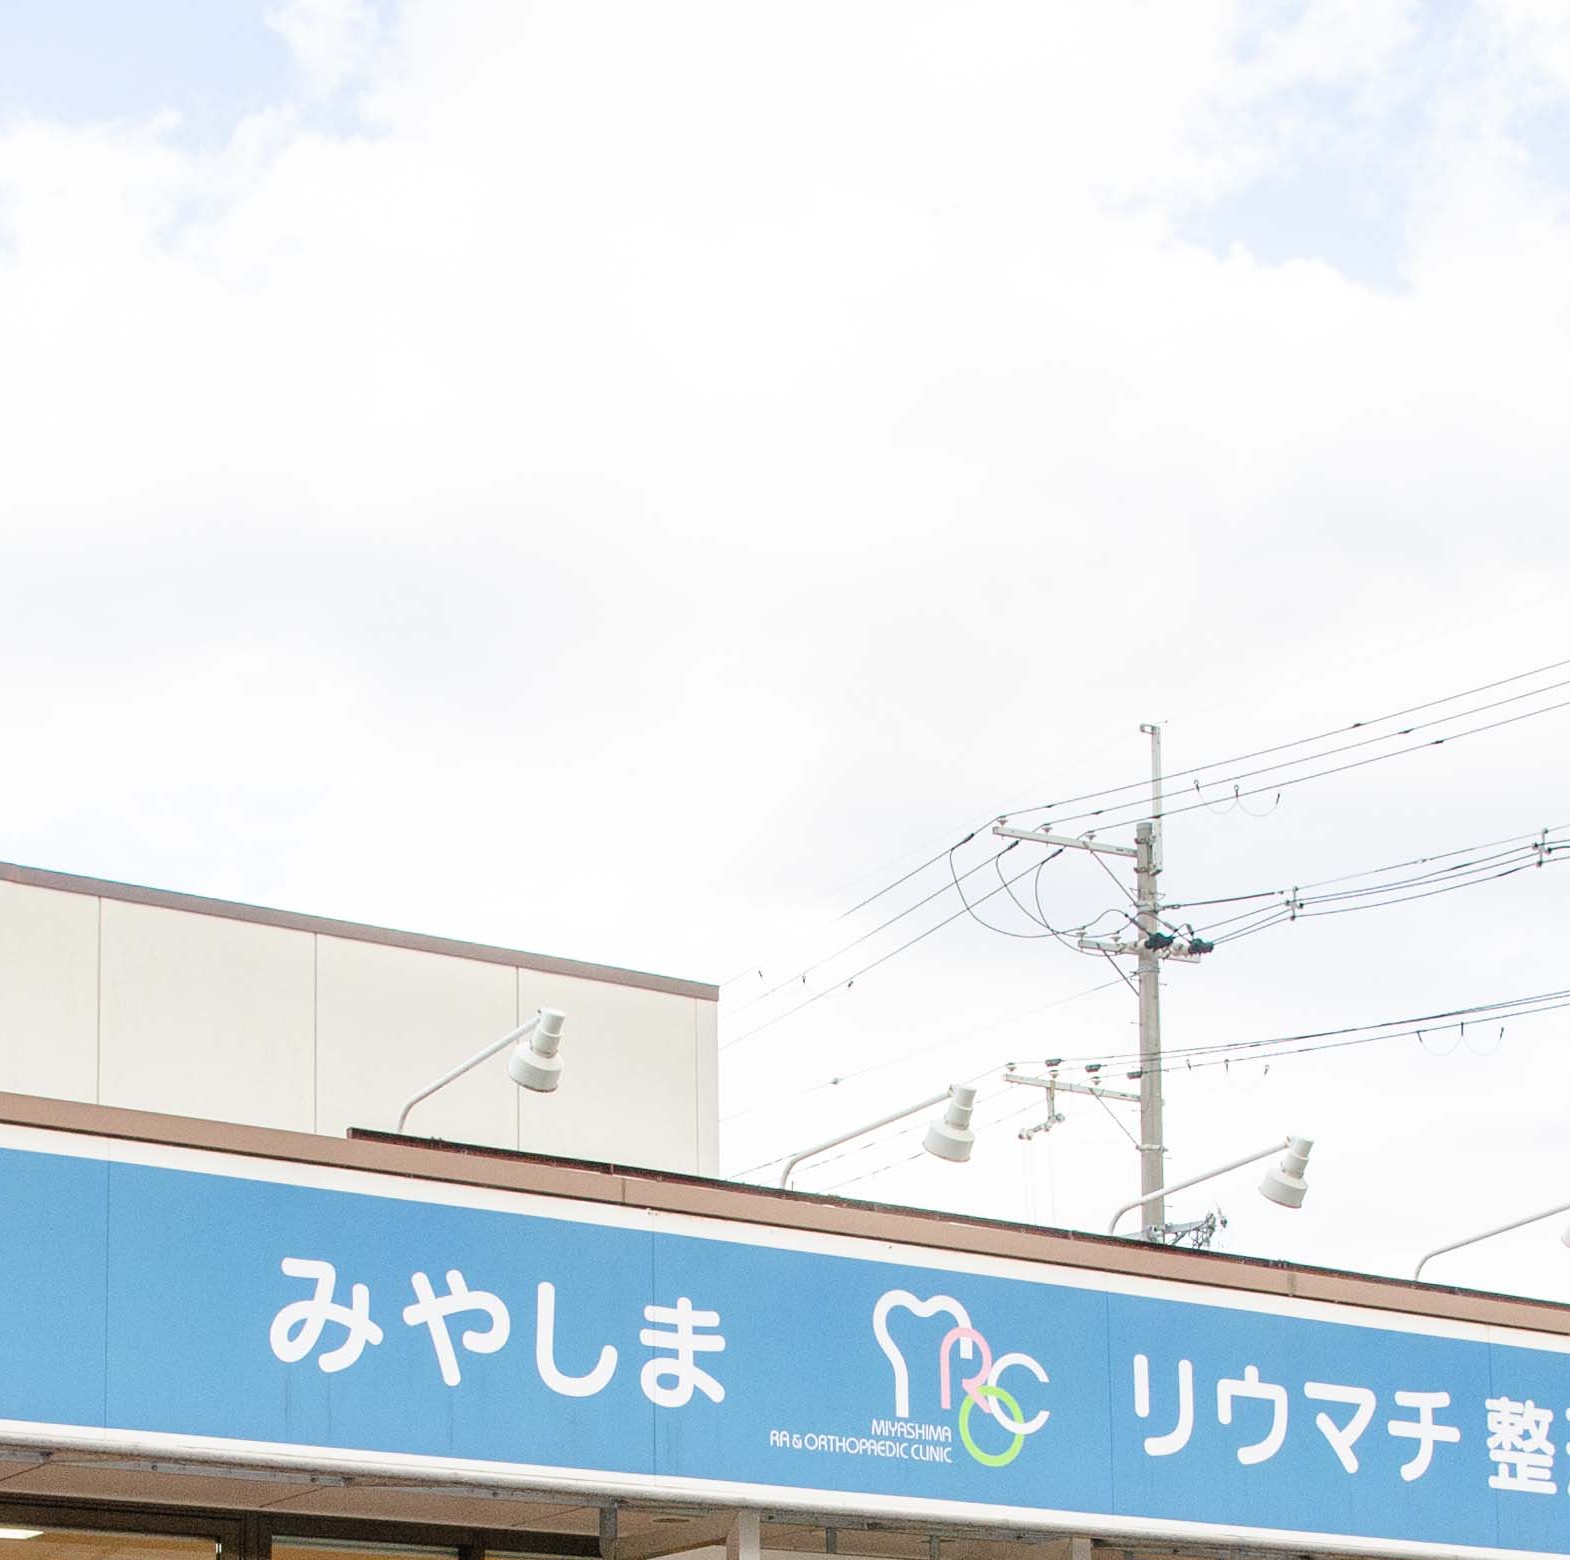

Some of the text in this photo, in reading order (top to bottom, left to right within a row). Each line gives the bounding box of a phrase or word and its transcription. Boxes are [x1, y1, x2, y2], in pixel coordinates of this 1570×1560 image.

[269, 1256, 727, 1408] みやしま
[769, 1429, 953, 1464] RA & ORTHOPAEDIC CLINIC
[871, 1418, 952, 1443] MIYASHIMA
[1132, 1353, 1460, 1481] リウマチ
